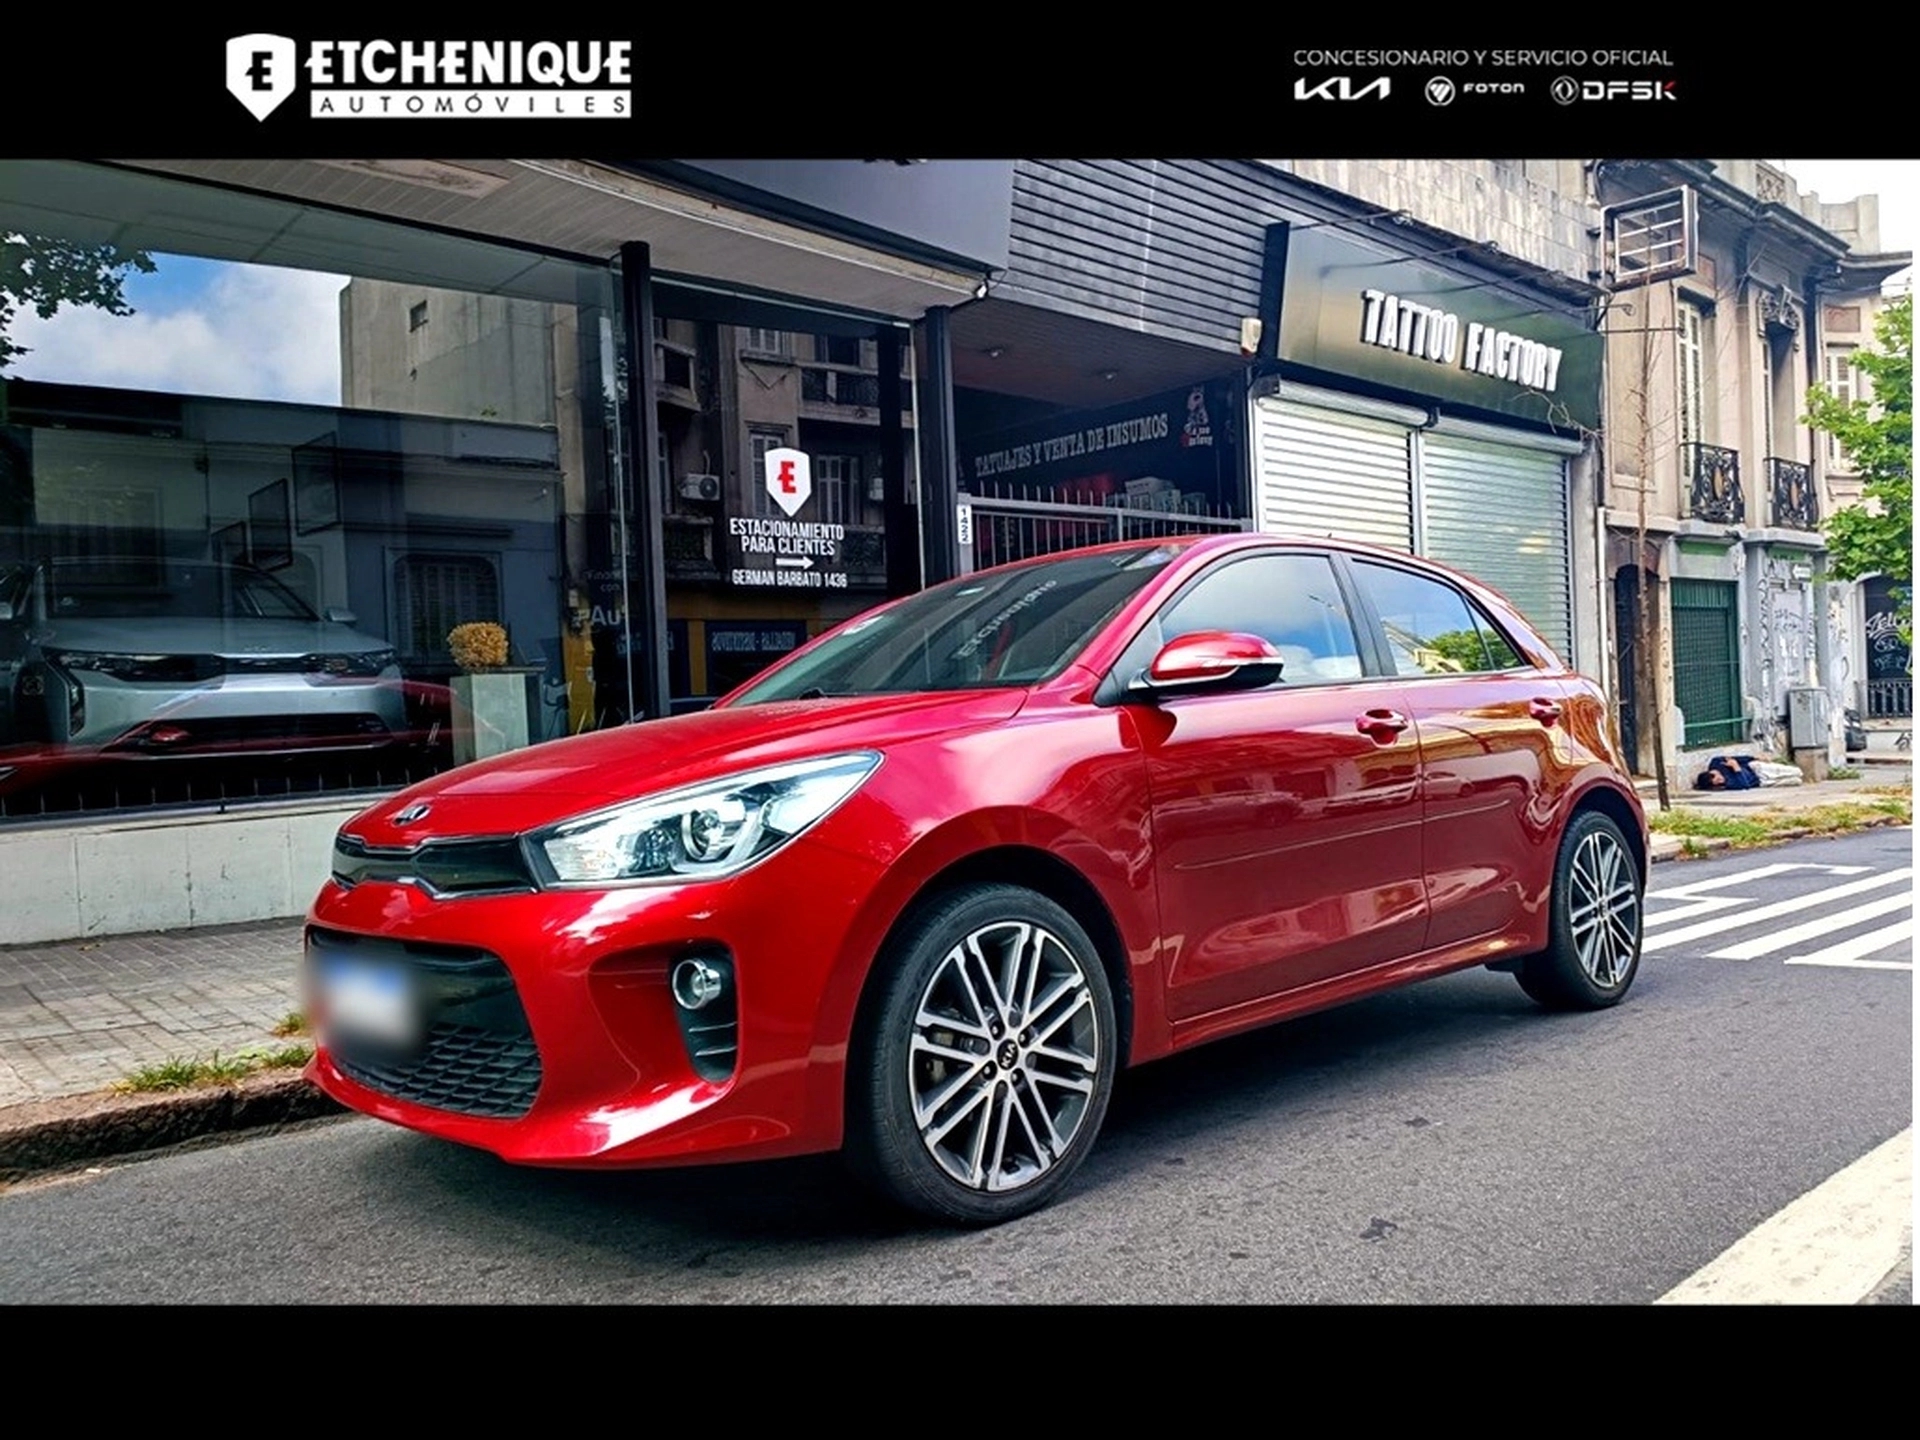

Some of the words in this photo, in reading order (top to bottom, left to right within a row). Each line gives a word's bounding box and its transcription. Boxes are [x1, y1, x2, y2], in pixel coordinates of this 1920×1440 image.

[1362, 289, 1459, 364] TATTOO
[1462, 322, 1562, 391] FACTORY
[975, 444, 1032, 477] TATUAJES
[1033, 441, 1042, 465] Y
[1043, 431, 1086, 462] VENTA
[1087, 426, 1104, 452] DE
[1106, 413, 1169, 447] INSUMOS
[776, 460, 797, 494] E
[730, 517, 844, 540] ESTACIONAMIENTO
[741, 536, 776, 553] PARA
[778, 538, 836, 556] CLIENTES
[732, 569, 775, 586] GERMAN
[777, 571, 822, 587] BARBATO
[824, 573, 847, 588] 1436
[1001, 1043, 1016, 1068] KIA
